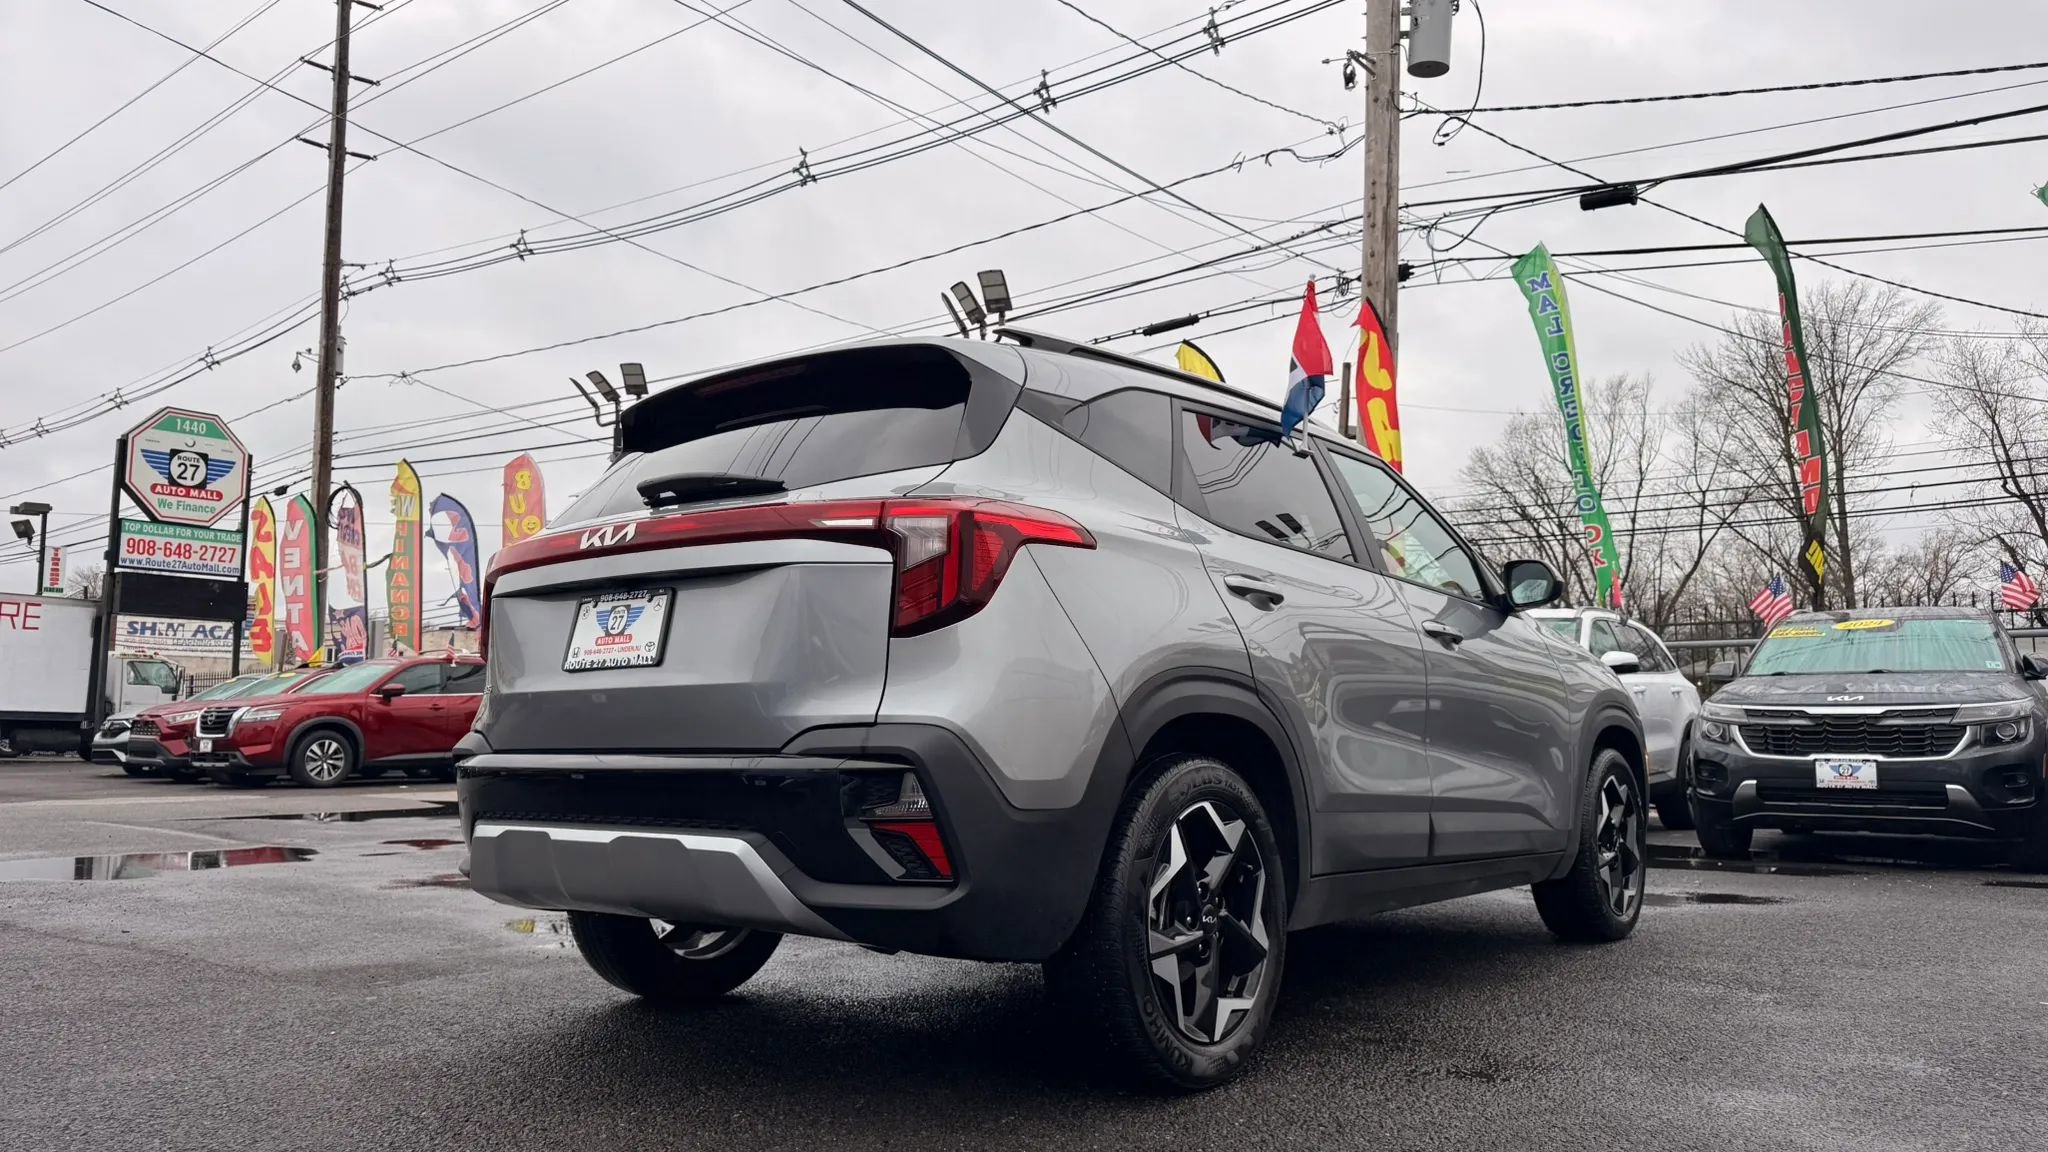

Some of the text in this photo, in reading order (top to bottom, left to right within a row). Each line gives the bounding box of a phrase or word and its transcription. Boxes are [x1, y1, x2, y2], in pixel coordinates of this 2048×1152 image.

[176, 418, 207, 434] 1440
[177, 455, 201, 463] ROUTE
[176, 462, 201, 481] 27
[154, 485, 220, 500] AUTO MALL
[157, 498, 216, 514] We Finance
[124, 522, 241, 543] TOP DOLLAR FOR YOUR TRADE
[579, 522, 637, 550] KIA
[126, 537, 237, 563] 908-648-2727
[120, 556, 240, 575] www.Route27AutoMall.com
[600, 590, 648, 602] 908-648-2727
[610, 614, 625, 631] 27
[614, 635, 631, 644] MALL
[564, 655, 653, 670] ROUTE 27 AUTO MALL
[1202, 914, 1217, 924] KIA
